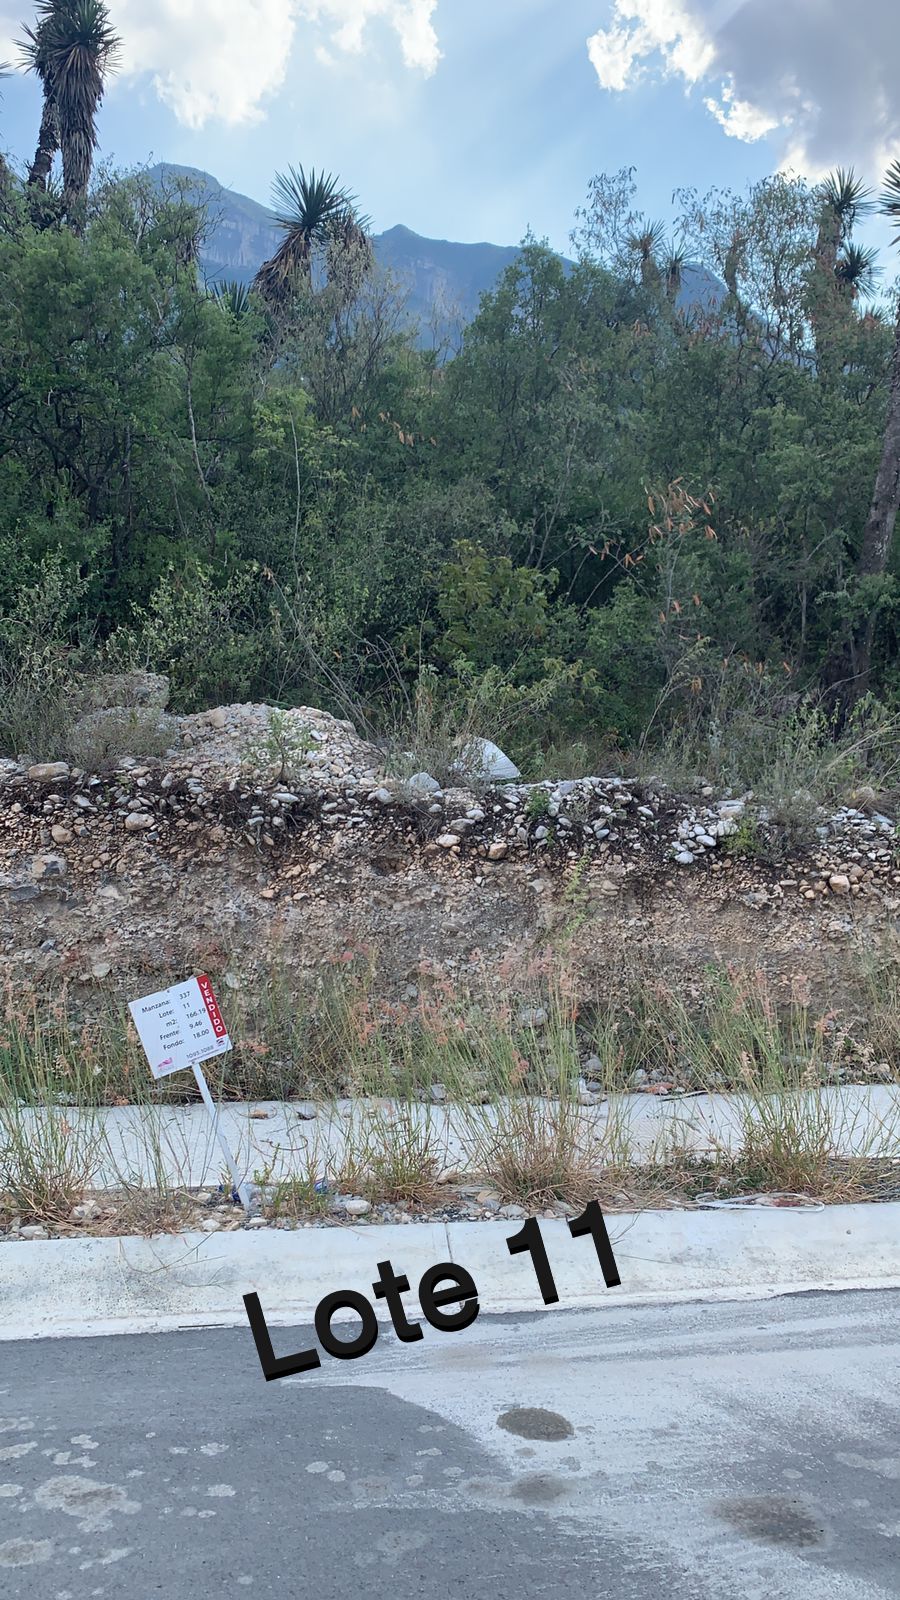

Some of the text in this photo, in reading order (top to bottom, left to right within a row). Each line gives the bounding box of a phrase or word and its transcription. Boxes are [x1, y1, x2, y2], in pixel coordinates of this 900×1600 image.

[141, 991, 191, 1013] Manzana: 337
[200, 982, 223, 1032] VENDIDO
[158, 1008, 175, 1018] Lote:
[166, 1007, 206, 1027] m2: 166.19
[159, 1020, 203, 1040] Frente: 9.46
[163, 1028, 210, 1050] Fondo: 18.00
